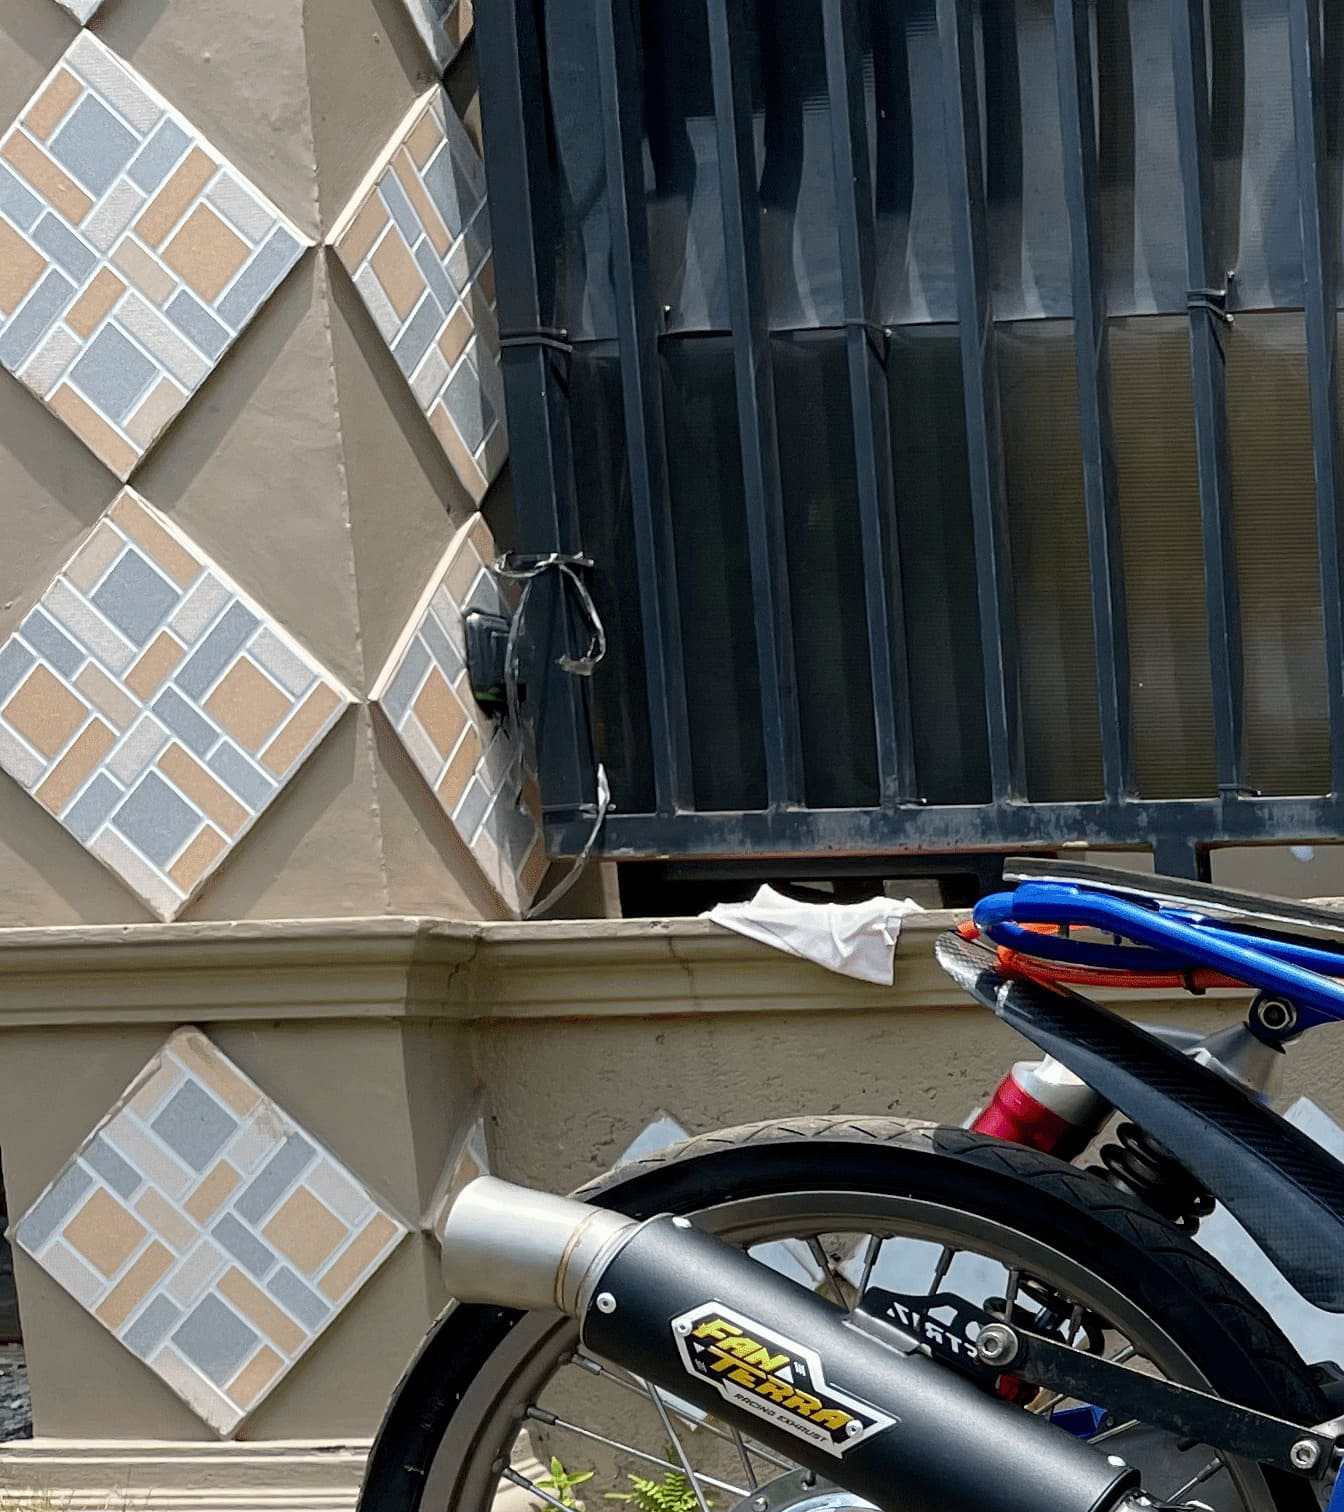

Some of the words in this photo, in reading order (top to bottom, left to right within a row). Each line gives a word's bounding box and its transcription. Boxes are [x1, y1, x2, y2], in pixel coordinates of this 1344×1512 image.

[692, 1319, 790, 1373] FAN
[708, 1345, 854, 1430] TERRA
[734, 1393, 775, 1416] RACING
[776, 1414, 829, 1443] EXHAUST
